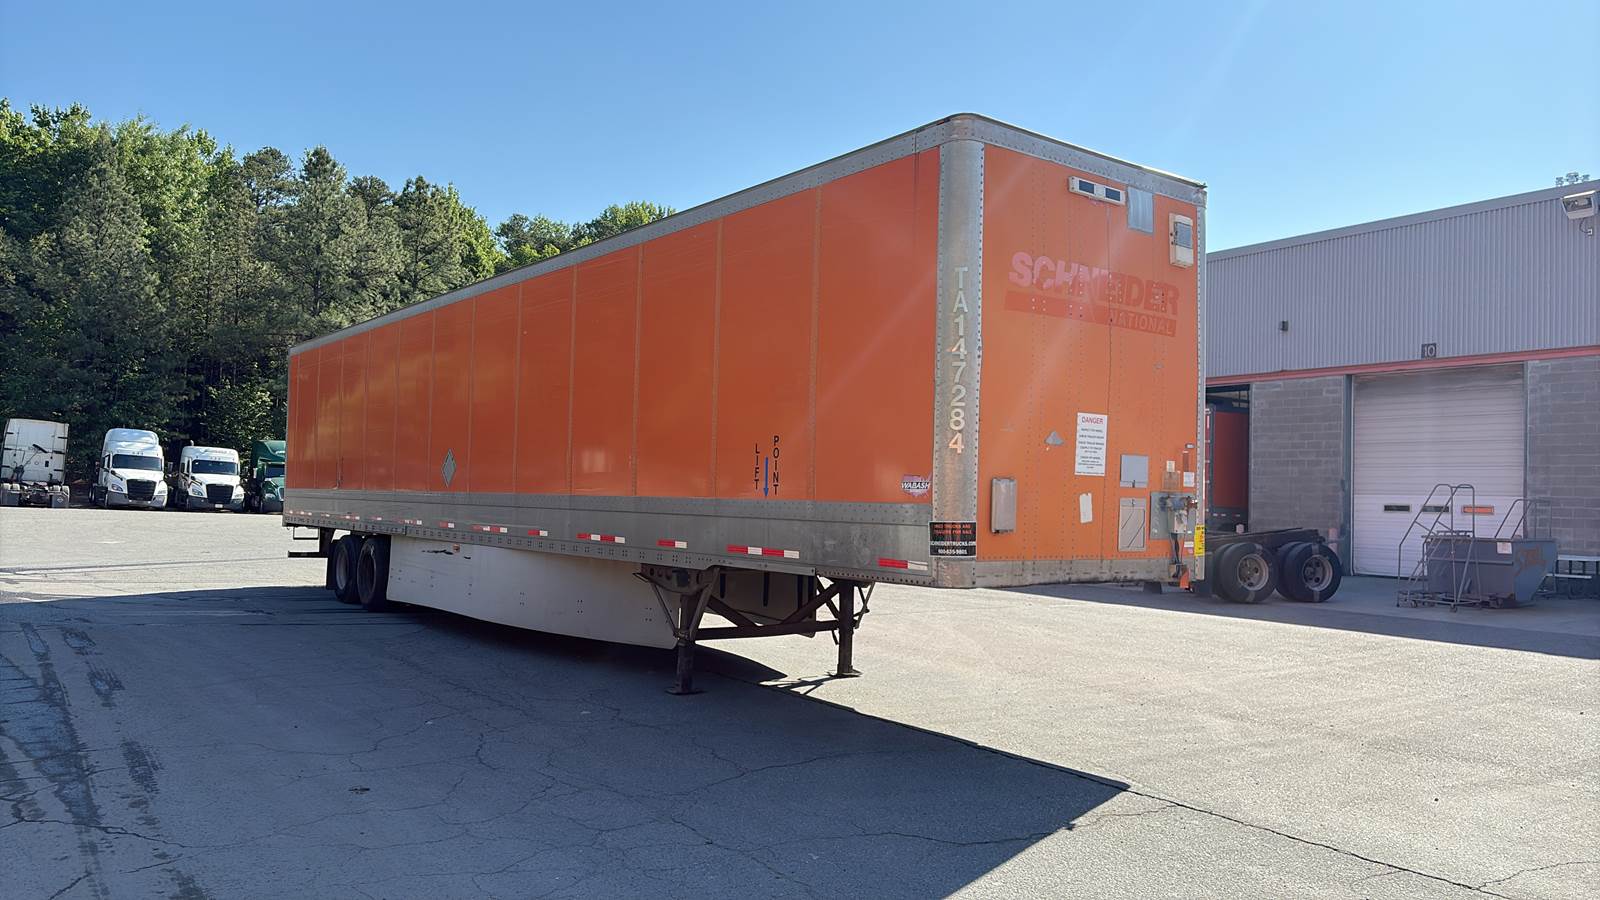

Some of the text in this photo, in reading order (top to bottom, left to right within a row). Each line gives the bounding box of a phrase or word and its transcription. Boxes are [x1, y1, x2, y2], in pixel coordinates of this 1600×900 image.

[1008, 252, 1180, 316] SCHNEIDER
[1107, 309, 1176, 336] NATIONAL
[949, 266, 968, 454] TA147284
[1424, 345, 1435, 356] 10
[1081, 416, 1104, 425] DANGER
